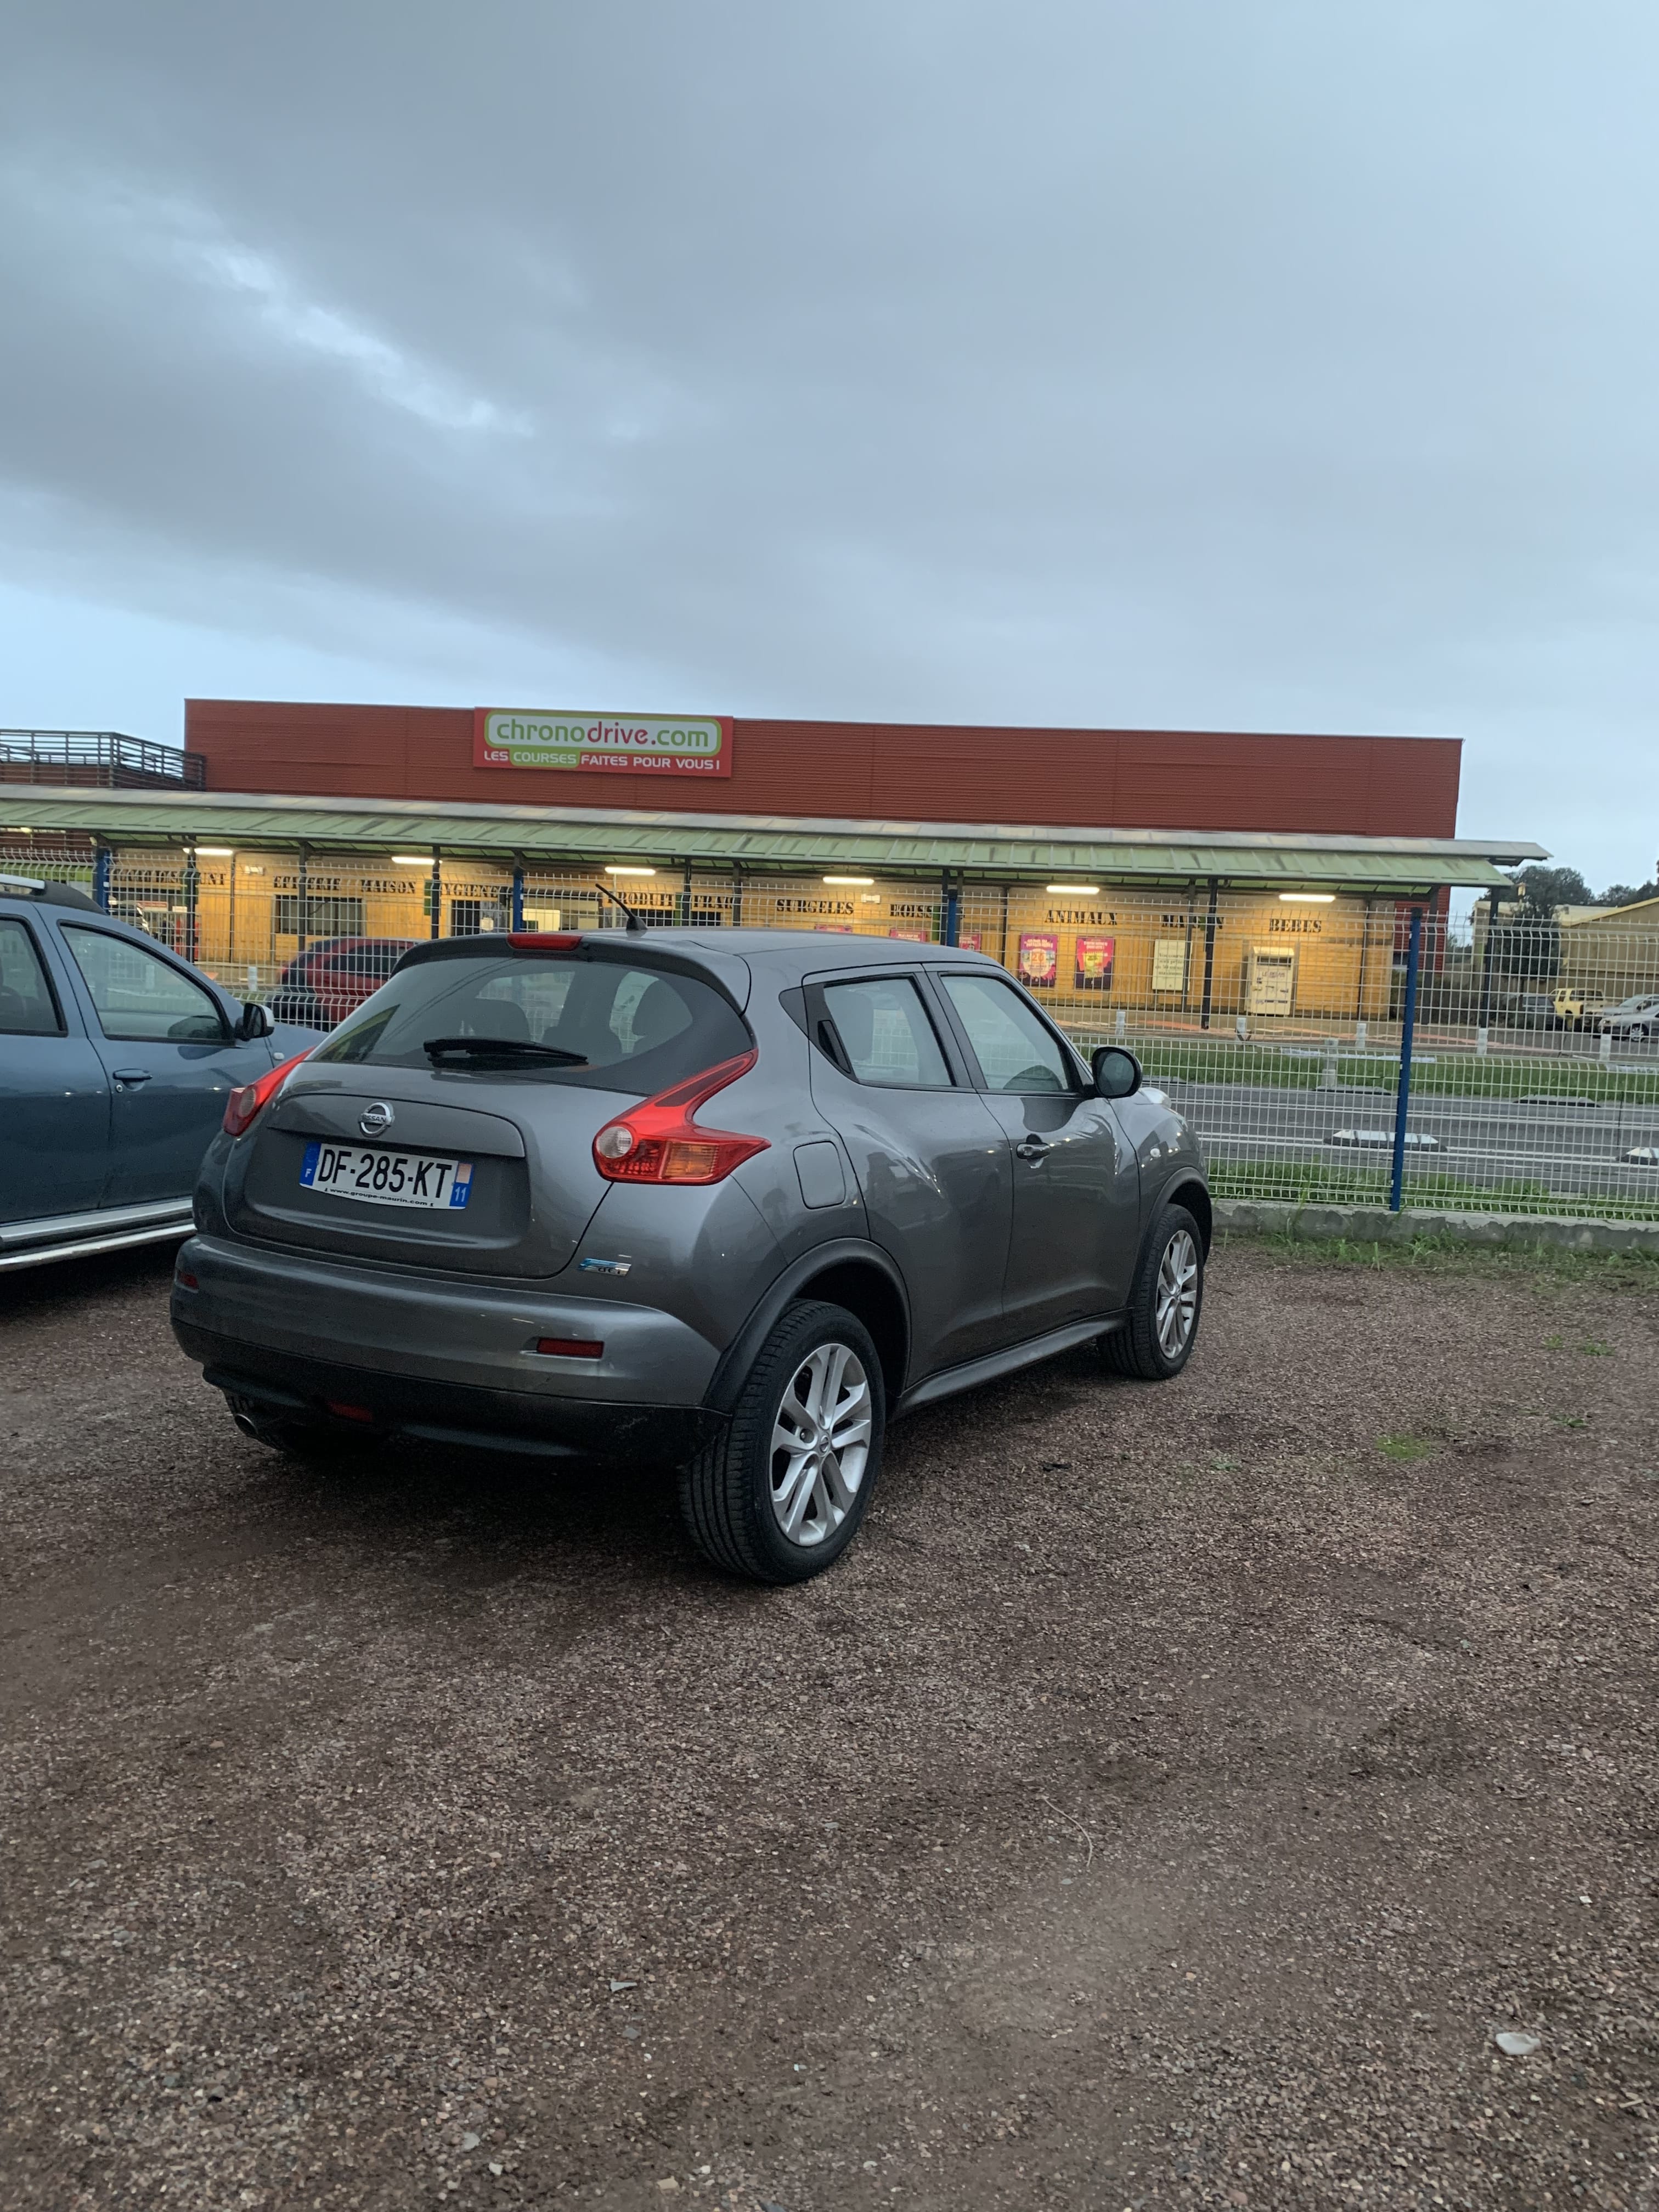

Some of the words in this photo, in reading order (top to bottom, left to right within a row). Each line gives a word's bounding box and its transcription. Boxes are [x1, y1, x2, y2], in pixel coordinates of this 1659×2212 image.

[496, 718, 708, 747] chronodrive.com
[484, 751, 509, 761] LES
[514, 752, 577, 764] COURSES
[580, 754, 628, 766] FAITES
[633, 757, 671, 768] POUR
[155, 870, 227, 885] DISUNT
[273, 876, 341, 891] EPIERIE
[361, 879, 417, 894] MAISON
[441, 883, 498, 898] YGIENE
[776, 899, 854, 915] SURGELES
[1045, 910, 1117, 925] ANIMAUX
[1161, 915, 1224, 929] MASN
[1269, 918, 1322, 933] BEBES
[305, 1168, 312, 1178] F
[318, 1149, 453, 1199] DF-285-KT
[455, 1186, 467, 1203] 11
[330, 1188, 428, 1206] www.groupe-maurin.com
